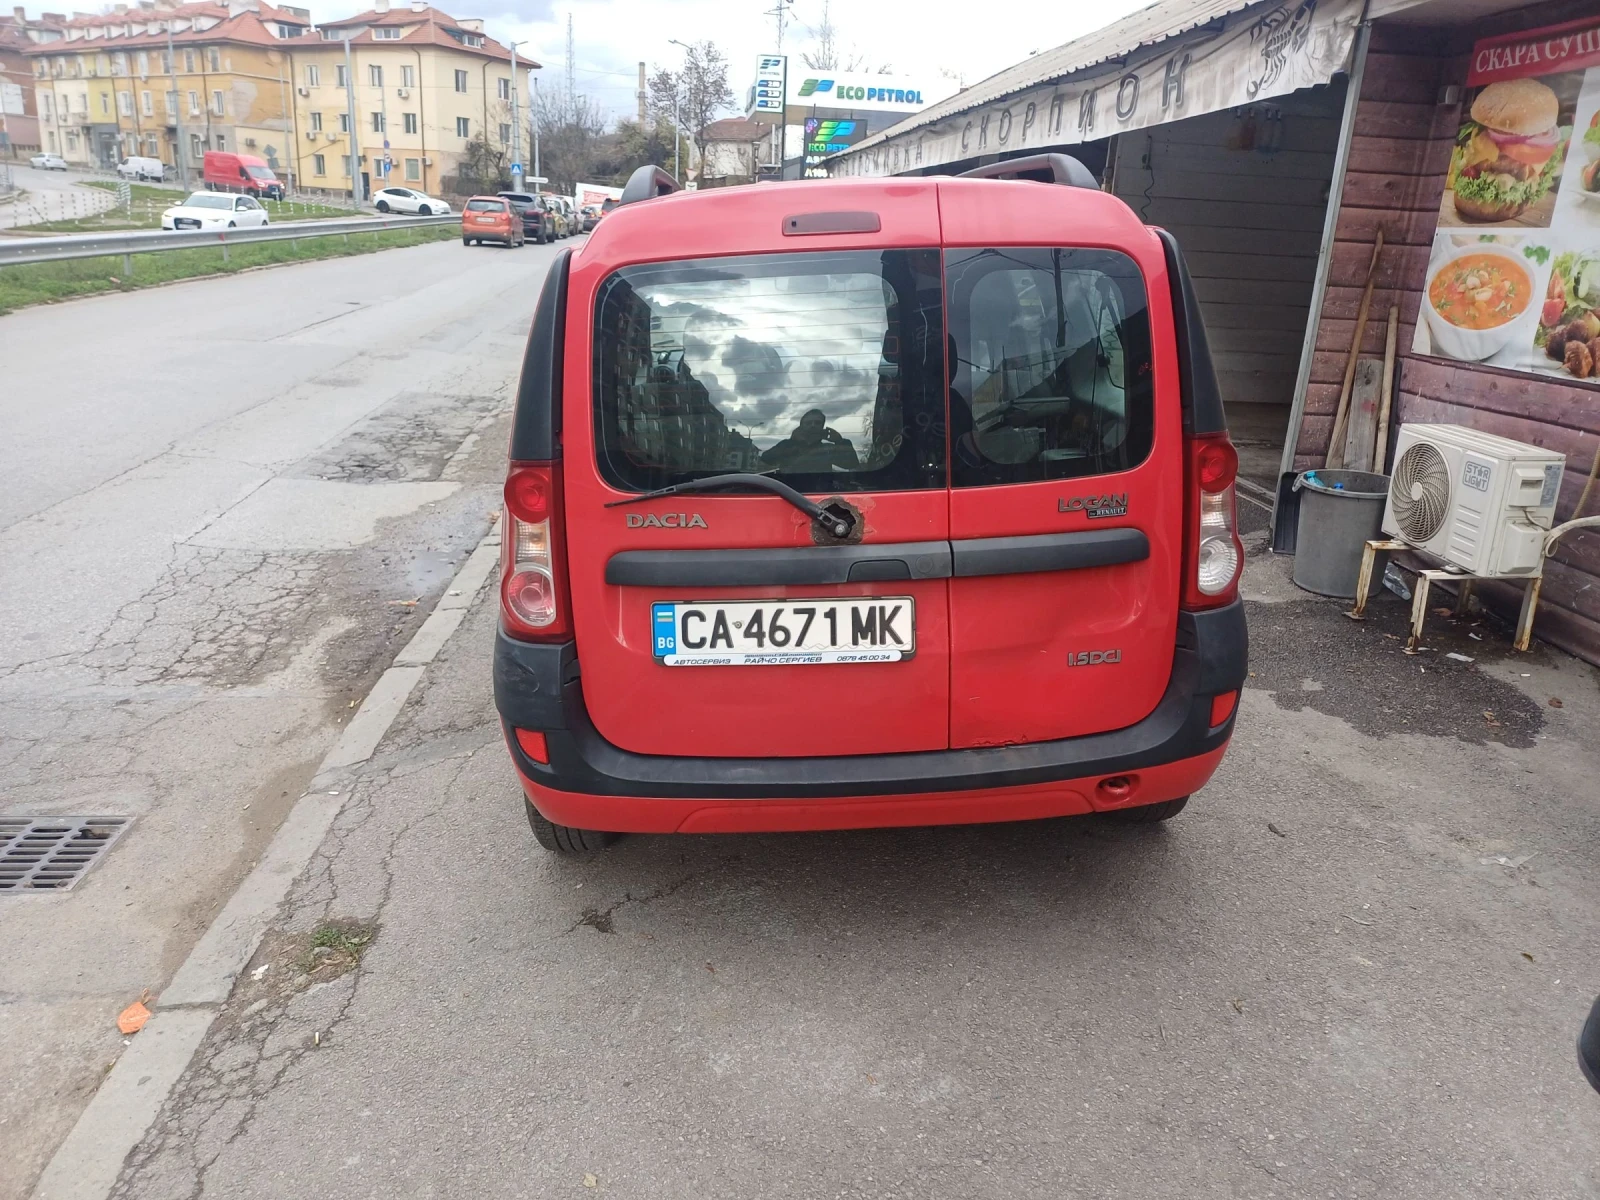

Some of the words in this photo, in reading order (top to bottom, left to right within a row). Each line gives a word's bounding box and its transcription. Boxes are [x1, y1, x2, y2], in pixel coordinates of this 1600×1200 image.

[1475, 42, 1540, 73] СКАРА
[836, 85, 865, 101] ECO
[867, 87, 924, 104] PETROL
[961, 52, 1193, 152] СКОРПИОН
[808, 143, 826, 152] ECO
[1464, 473, 1487, 489] LIGHT
[1058, 492, 1128, 512] LOGAN
[1096, 507, 1125, 516] RENAULT
[625, 513, 708, 529] DACIA
[681, 609, 735, 650] CA
[743, 606, 838, 649] 4671
[851, 605, 904, 647] MK
[657, 637, 675, 648] BG
[778, 656, 823, 664] СЕРГИЕВ
